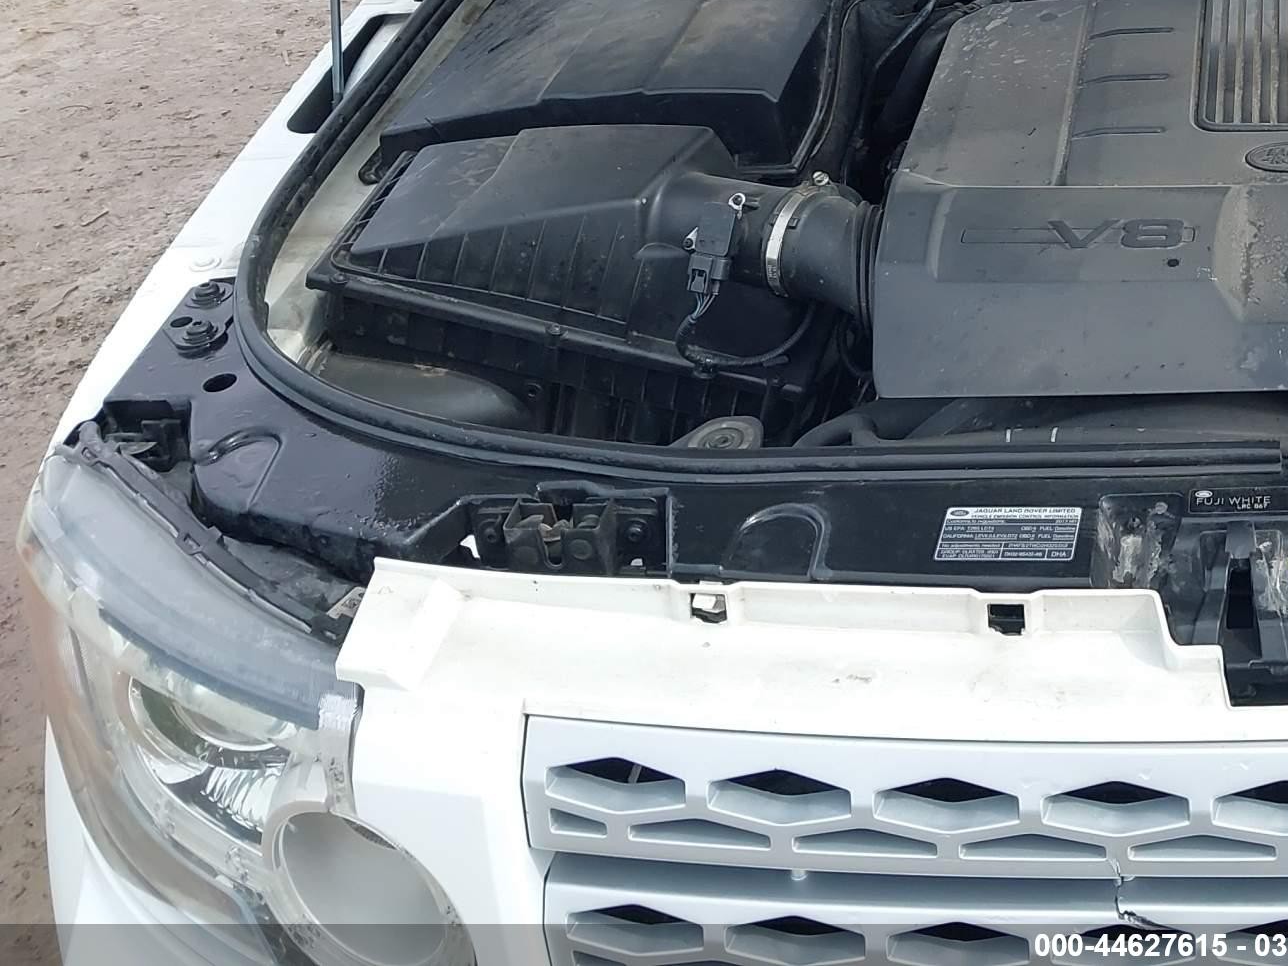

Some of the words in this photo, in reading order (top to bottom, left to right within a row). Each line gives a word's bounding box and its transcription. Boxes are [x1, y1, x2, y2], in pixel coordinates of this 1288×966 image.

[1047, 218, 1185, 249] V8
[1196, 497, 1224, 506] FUJI
[1228, 496, 1272, 505] WHITE
